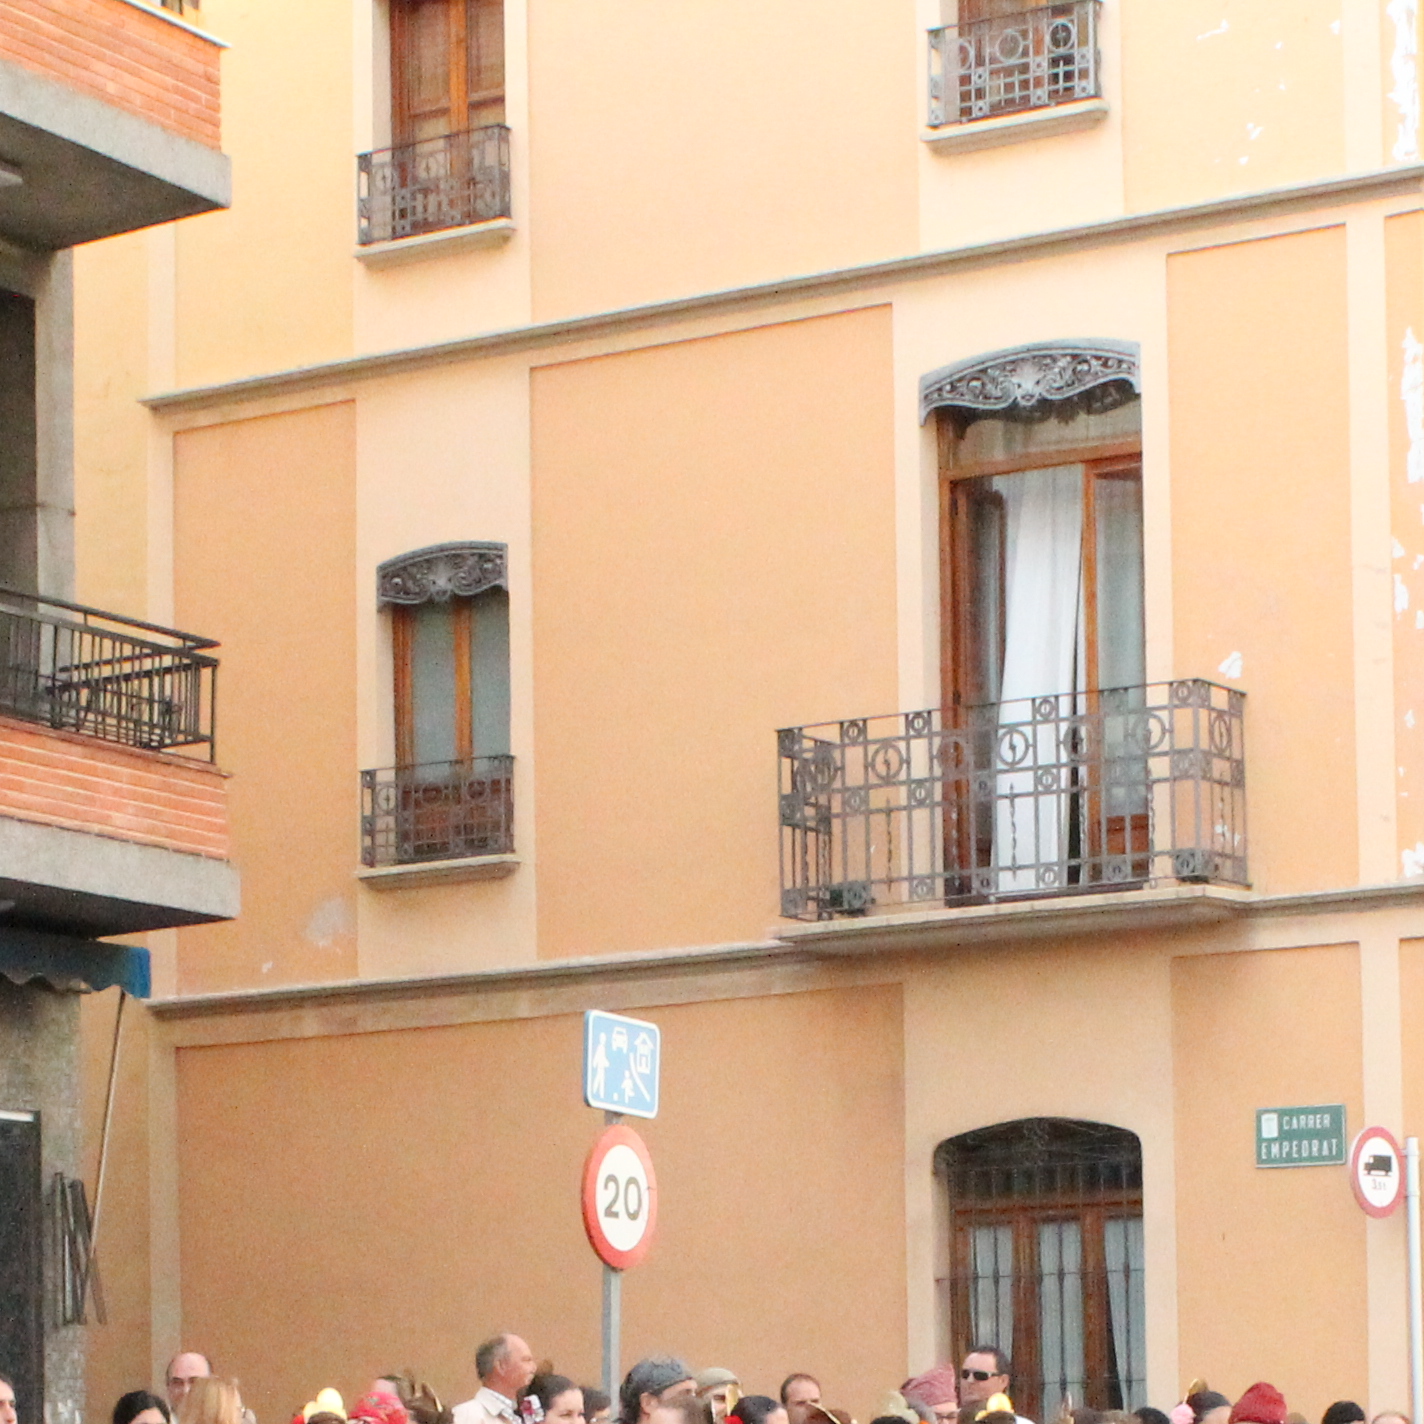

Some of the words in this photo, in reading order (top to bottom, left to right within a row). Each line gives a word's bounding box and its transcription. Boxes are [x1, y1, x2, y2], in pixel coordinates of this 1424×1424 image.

[1282, 1113, 1331, 1130] CARRER
[1261, 1138, 1338, 1160] EMPEDRAT
[603, 1173, 643, 1221] 20
